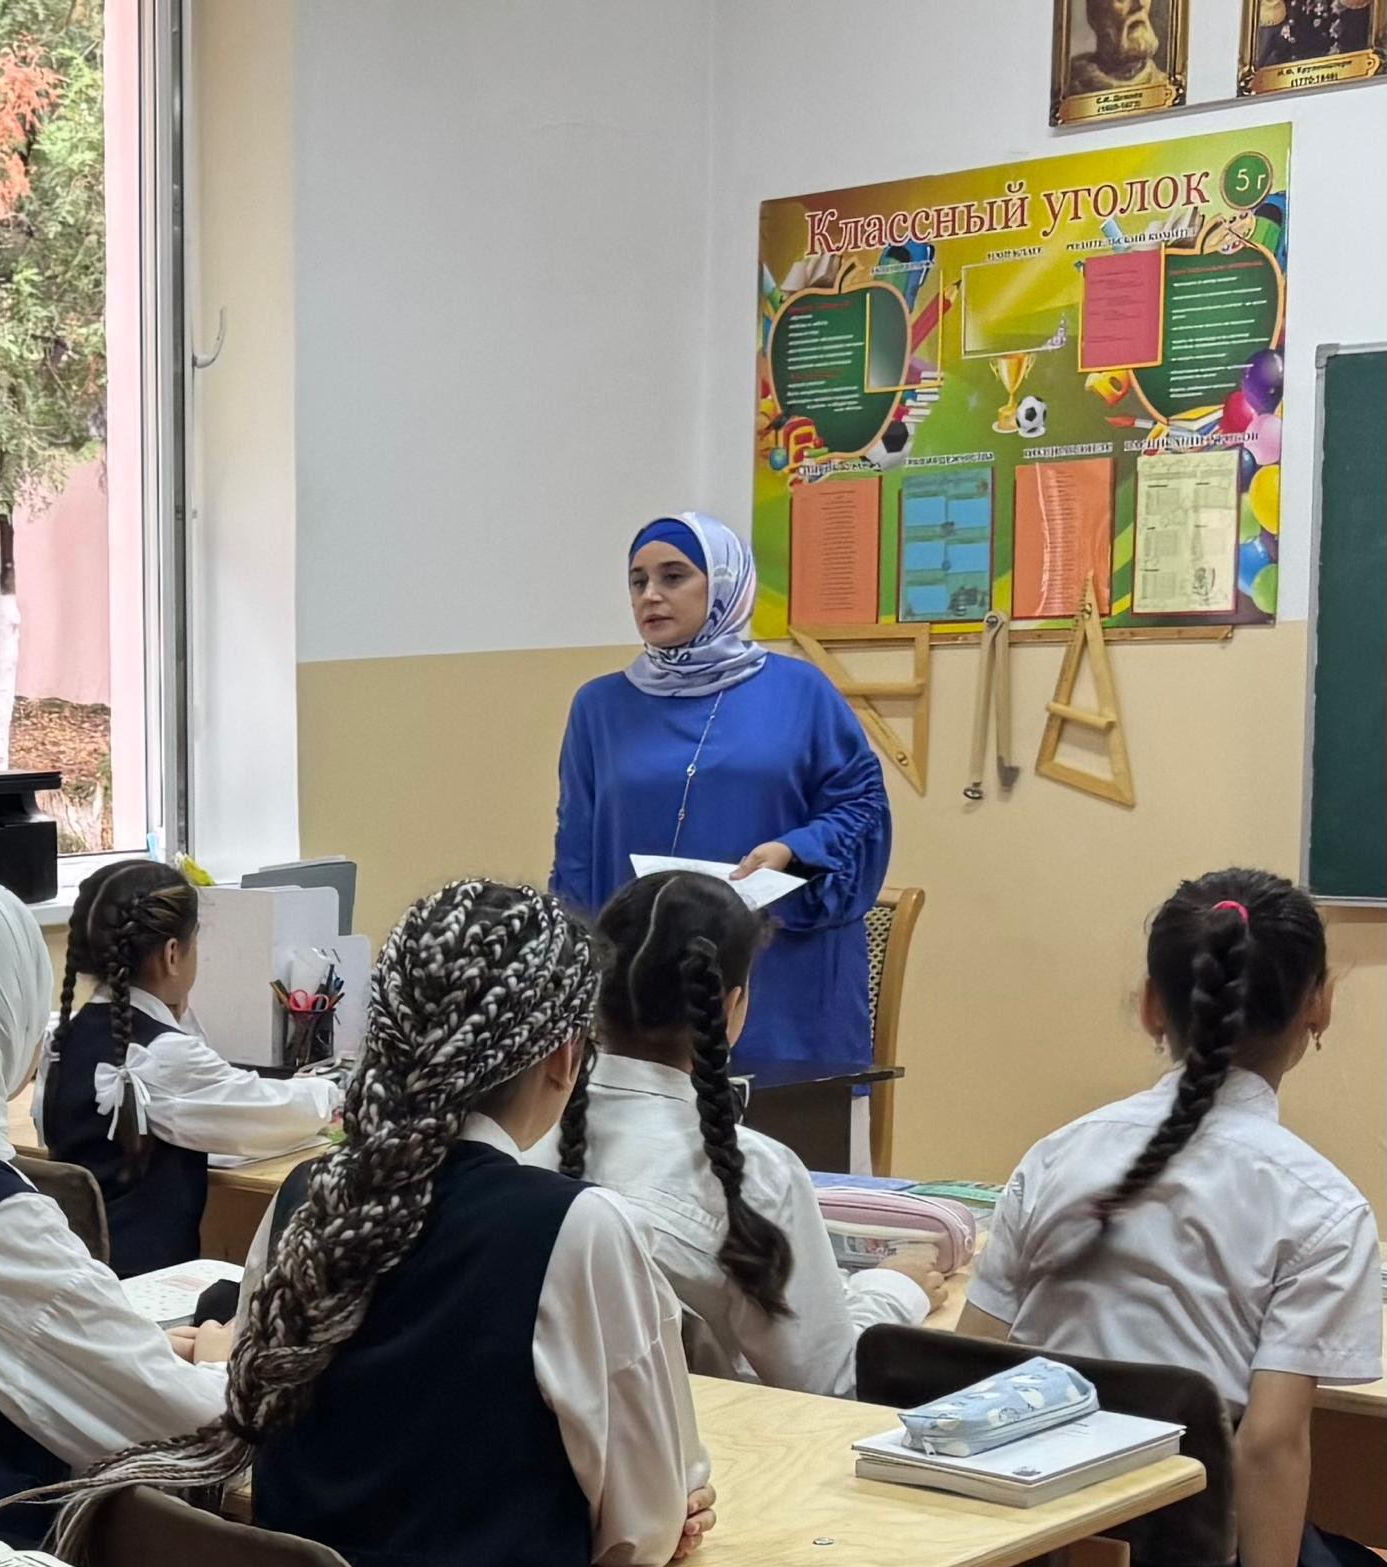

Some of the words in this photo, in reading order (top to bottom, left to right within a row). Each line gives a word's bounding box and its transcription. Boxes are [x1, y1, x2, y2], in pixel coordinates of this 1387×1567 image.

[1235, 168, 1251, 192] 5
[805, 181, 1030, 256] Классный
[1042, 171, 1211, 238] уголок
